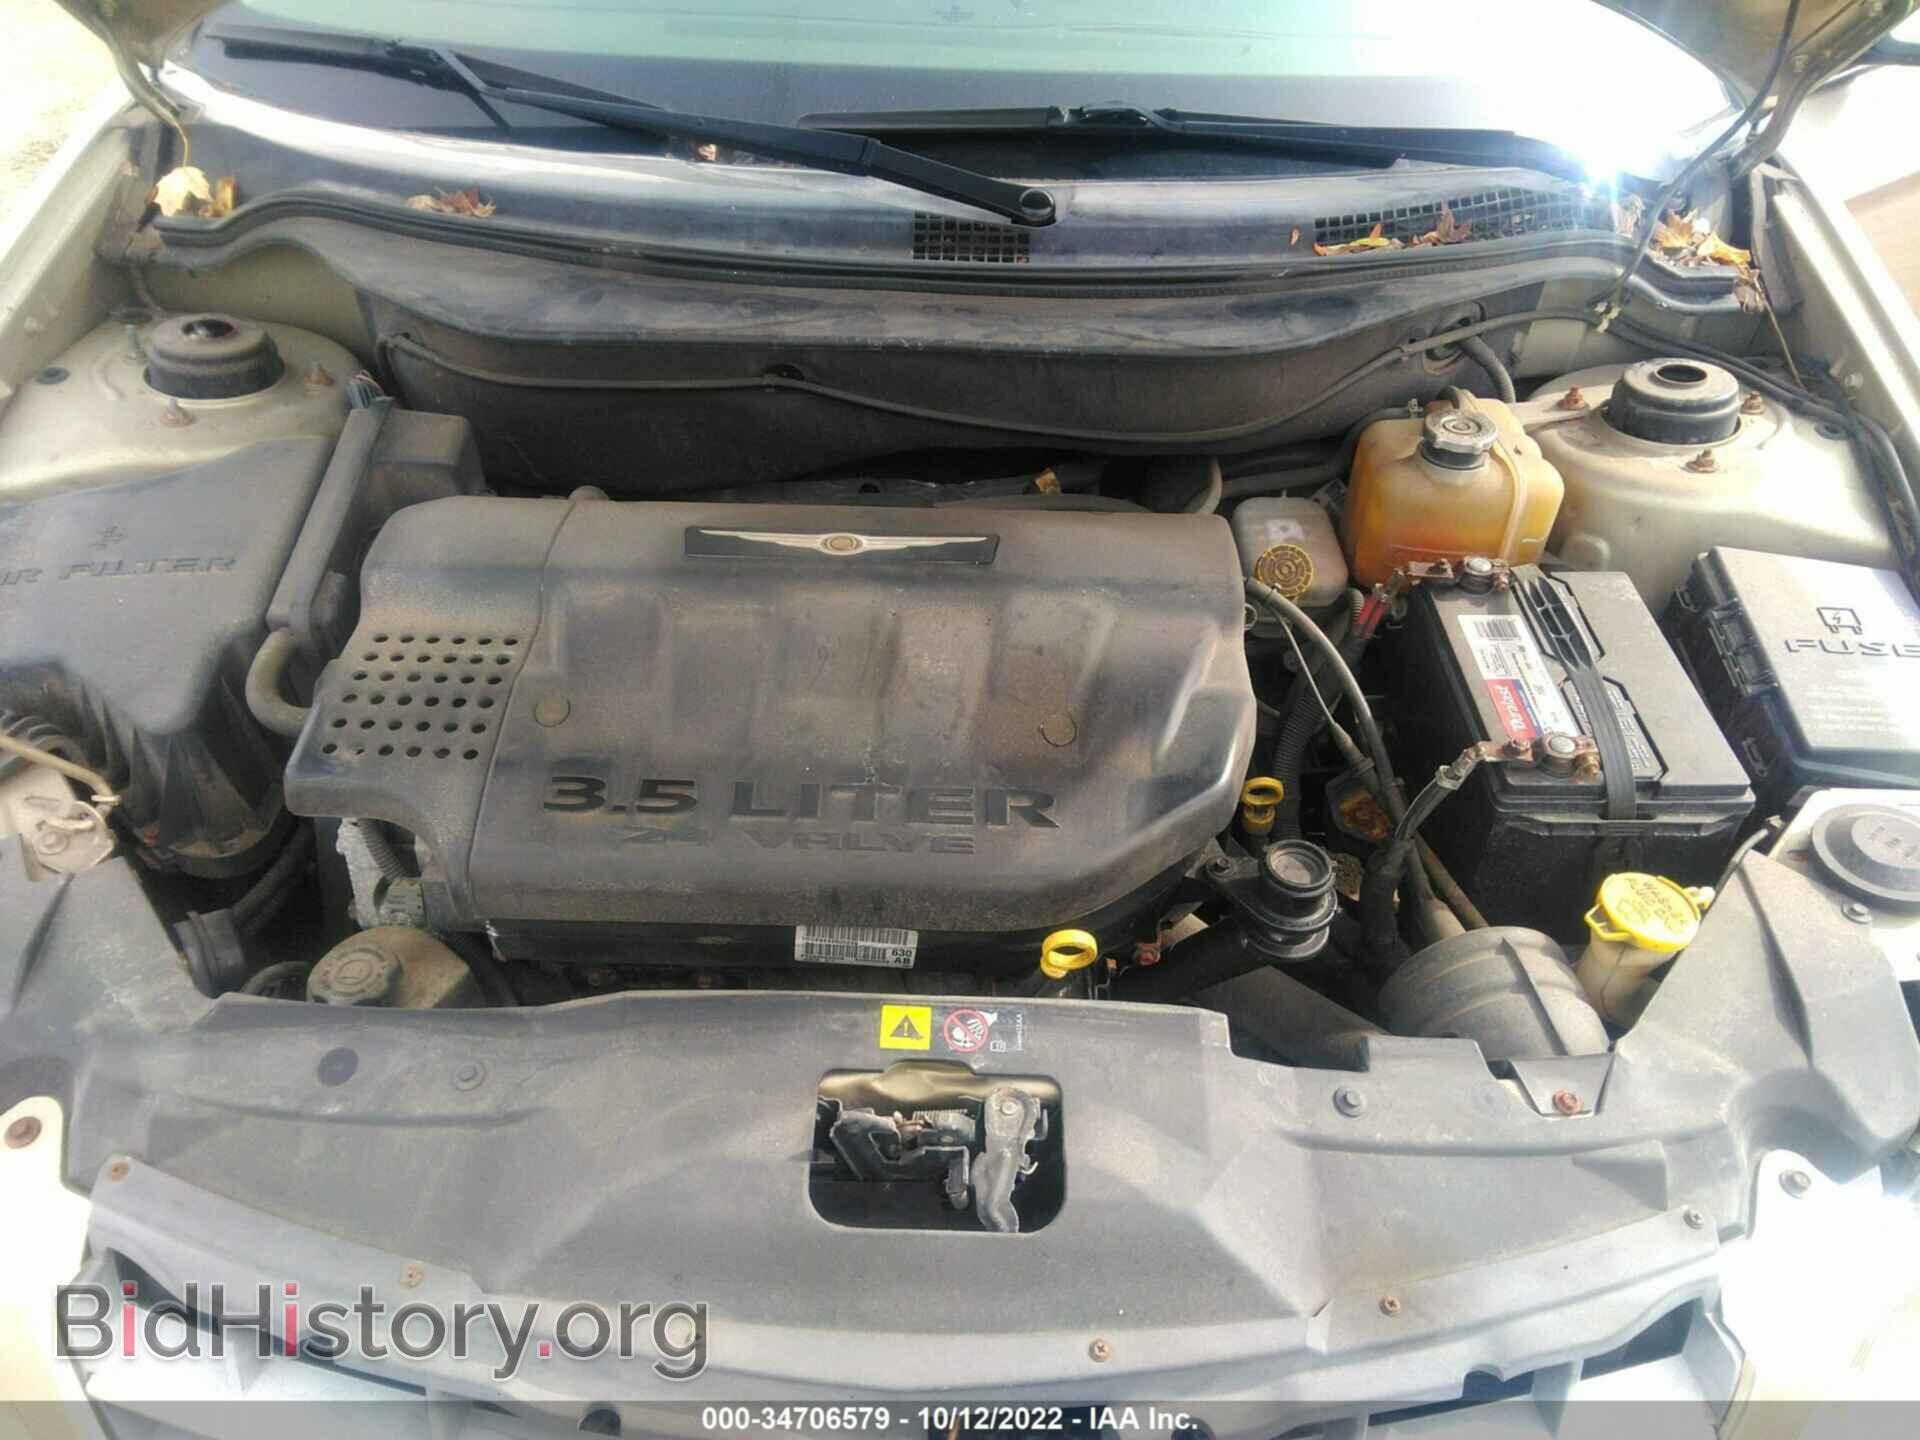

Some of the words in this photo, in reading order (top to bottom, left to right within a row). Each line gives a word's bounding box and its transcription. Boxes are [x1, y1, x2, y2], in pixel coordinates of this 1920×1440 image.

[57, 556, 237, 581] FILTER
[1784, 638, 1920, 659] FUSE
[543, 776, 698, 814] 3.5
[729, 780, 1059, 829] LITER
[742, 829, 975, 855] VALVE
